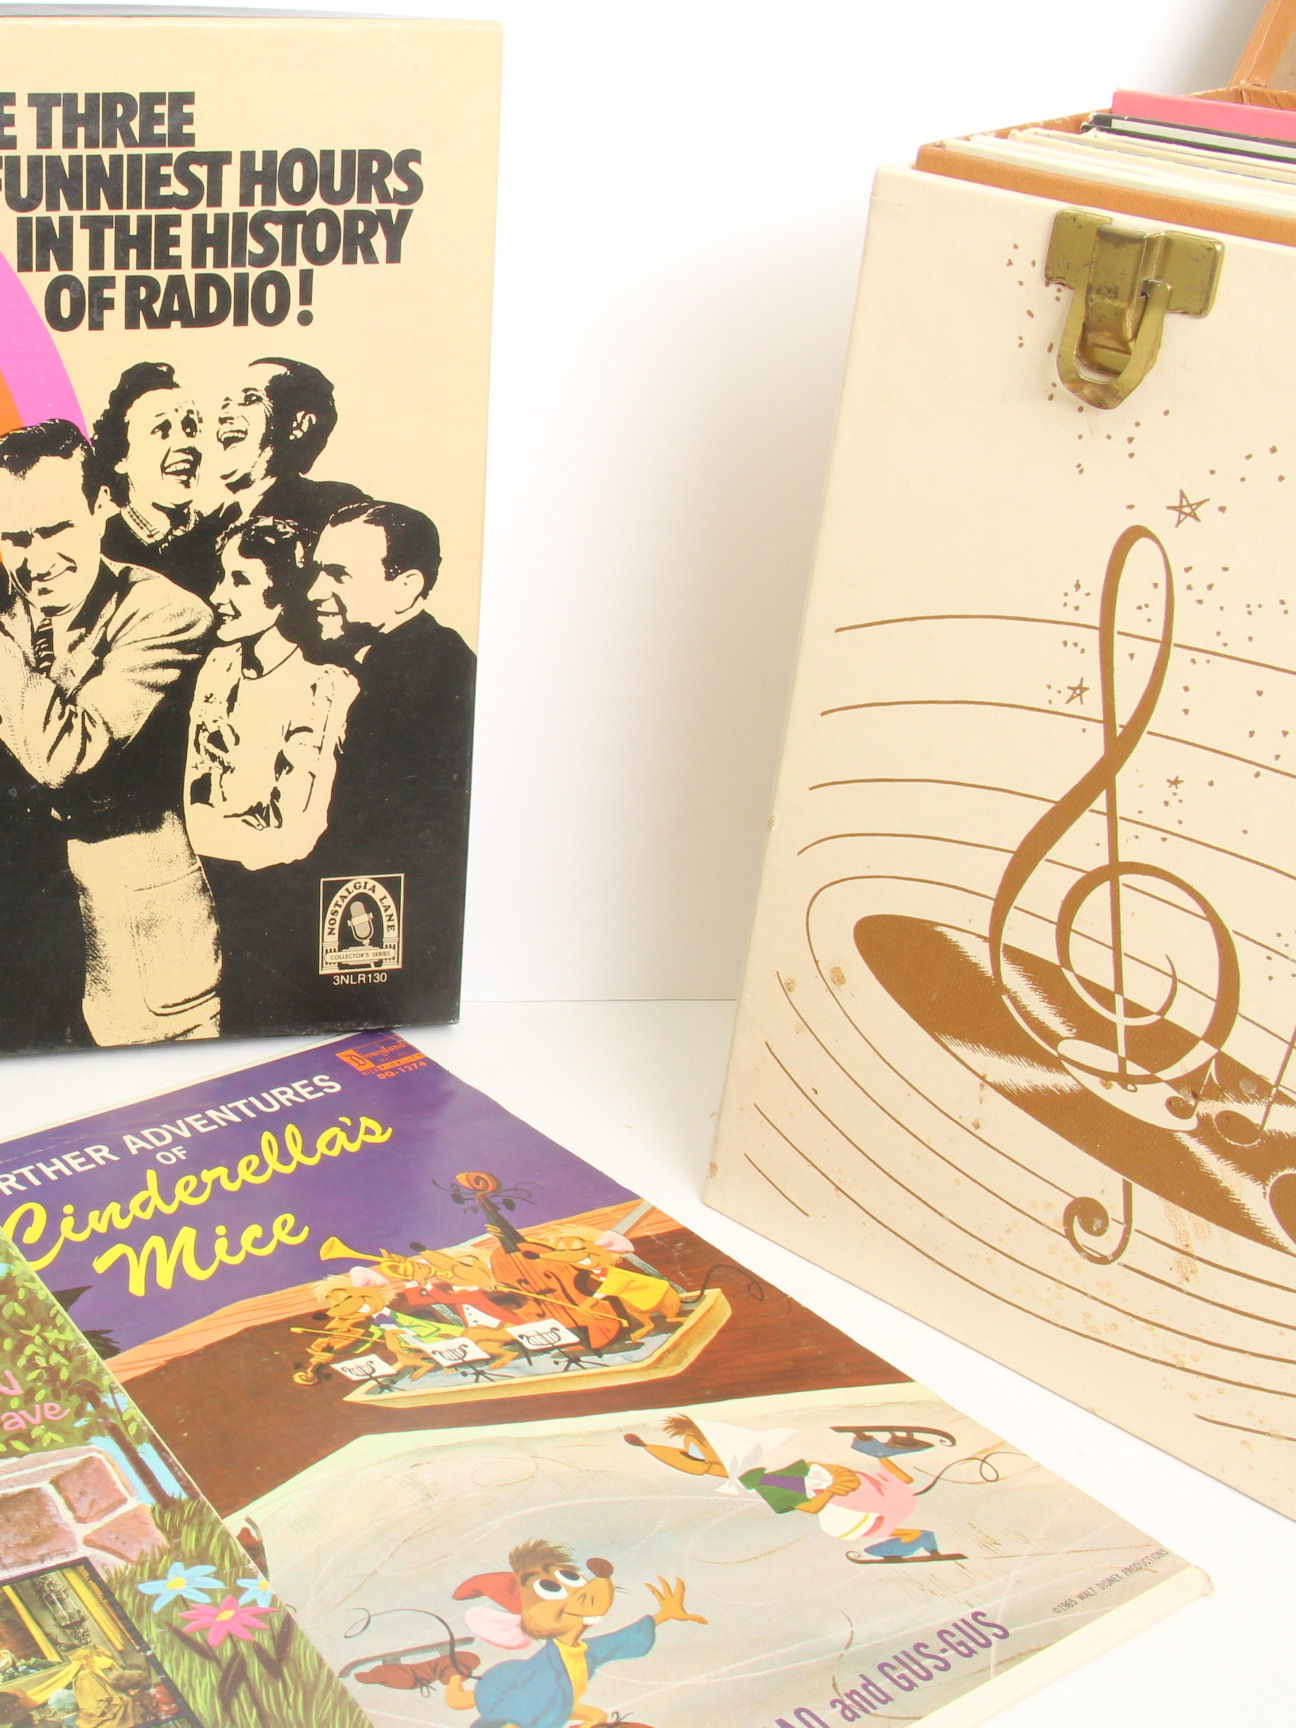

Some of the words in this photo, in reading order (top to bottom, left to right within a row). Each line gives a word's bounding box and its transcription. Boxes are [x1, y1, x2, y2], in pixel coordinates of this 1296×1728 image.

[27, 91, 196, 149] THREE
[239, 148, 424, 206] HOURS
[16, 216, 73, 272] IN
[80, 214, 182, 270] THE
[191, 208, 414, 269] HISTORY
[44, 273, 116, 332] OF
[124, 268, 314, 330] RADIO!
[327, 881, 376, 936] NOSTALGIA
[379, 895, 395, 932] LANE
[332, 972, 388, 986] 3NLR130
[372, 950, 391, 958] SERIES
[123, 1073, 343, 1156] ADVENTURES
[155, 1144, 190, 1166] OF
[2, 1115, 394, 1272] Cinderella's
[92, 1212, 310, 1298] Mice
[1077, 1586, 1098, 1601] WALT
[1096, 1573, 1124, 1591] DISNEY
[1120, 1548, 1170, 1577] PRODUCTIONS
[829, 1673, 894, 1723] and
[877, 1610, 1010, 1692] GUS-GUS
